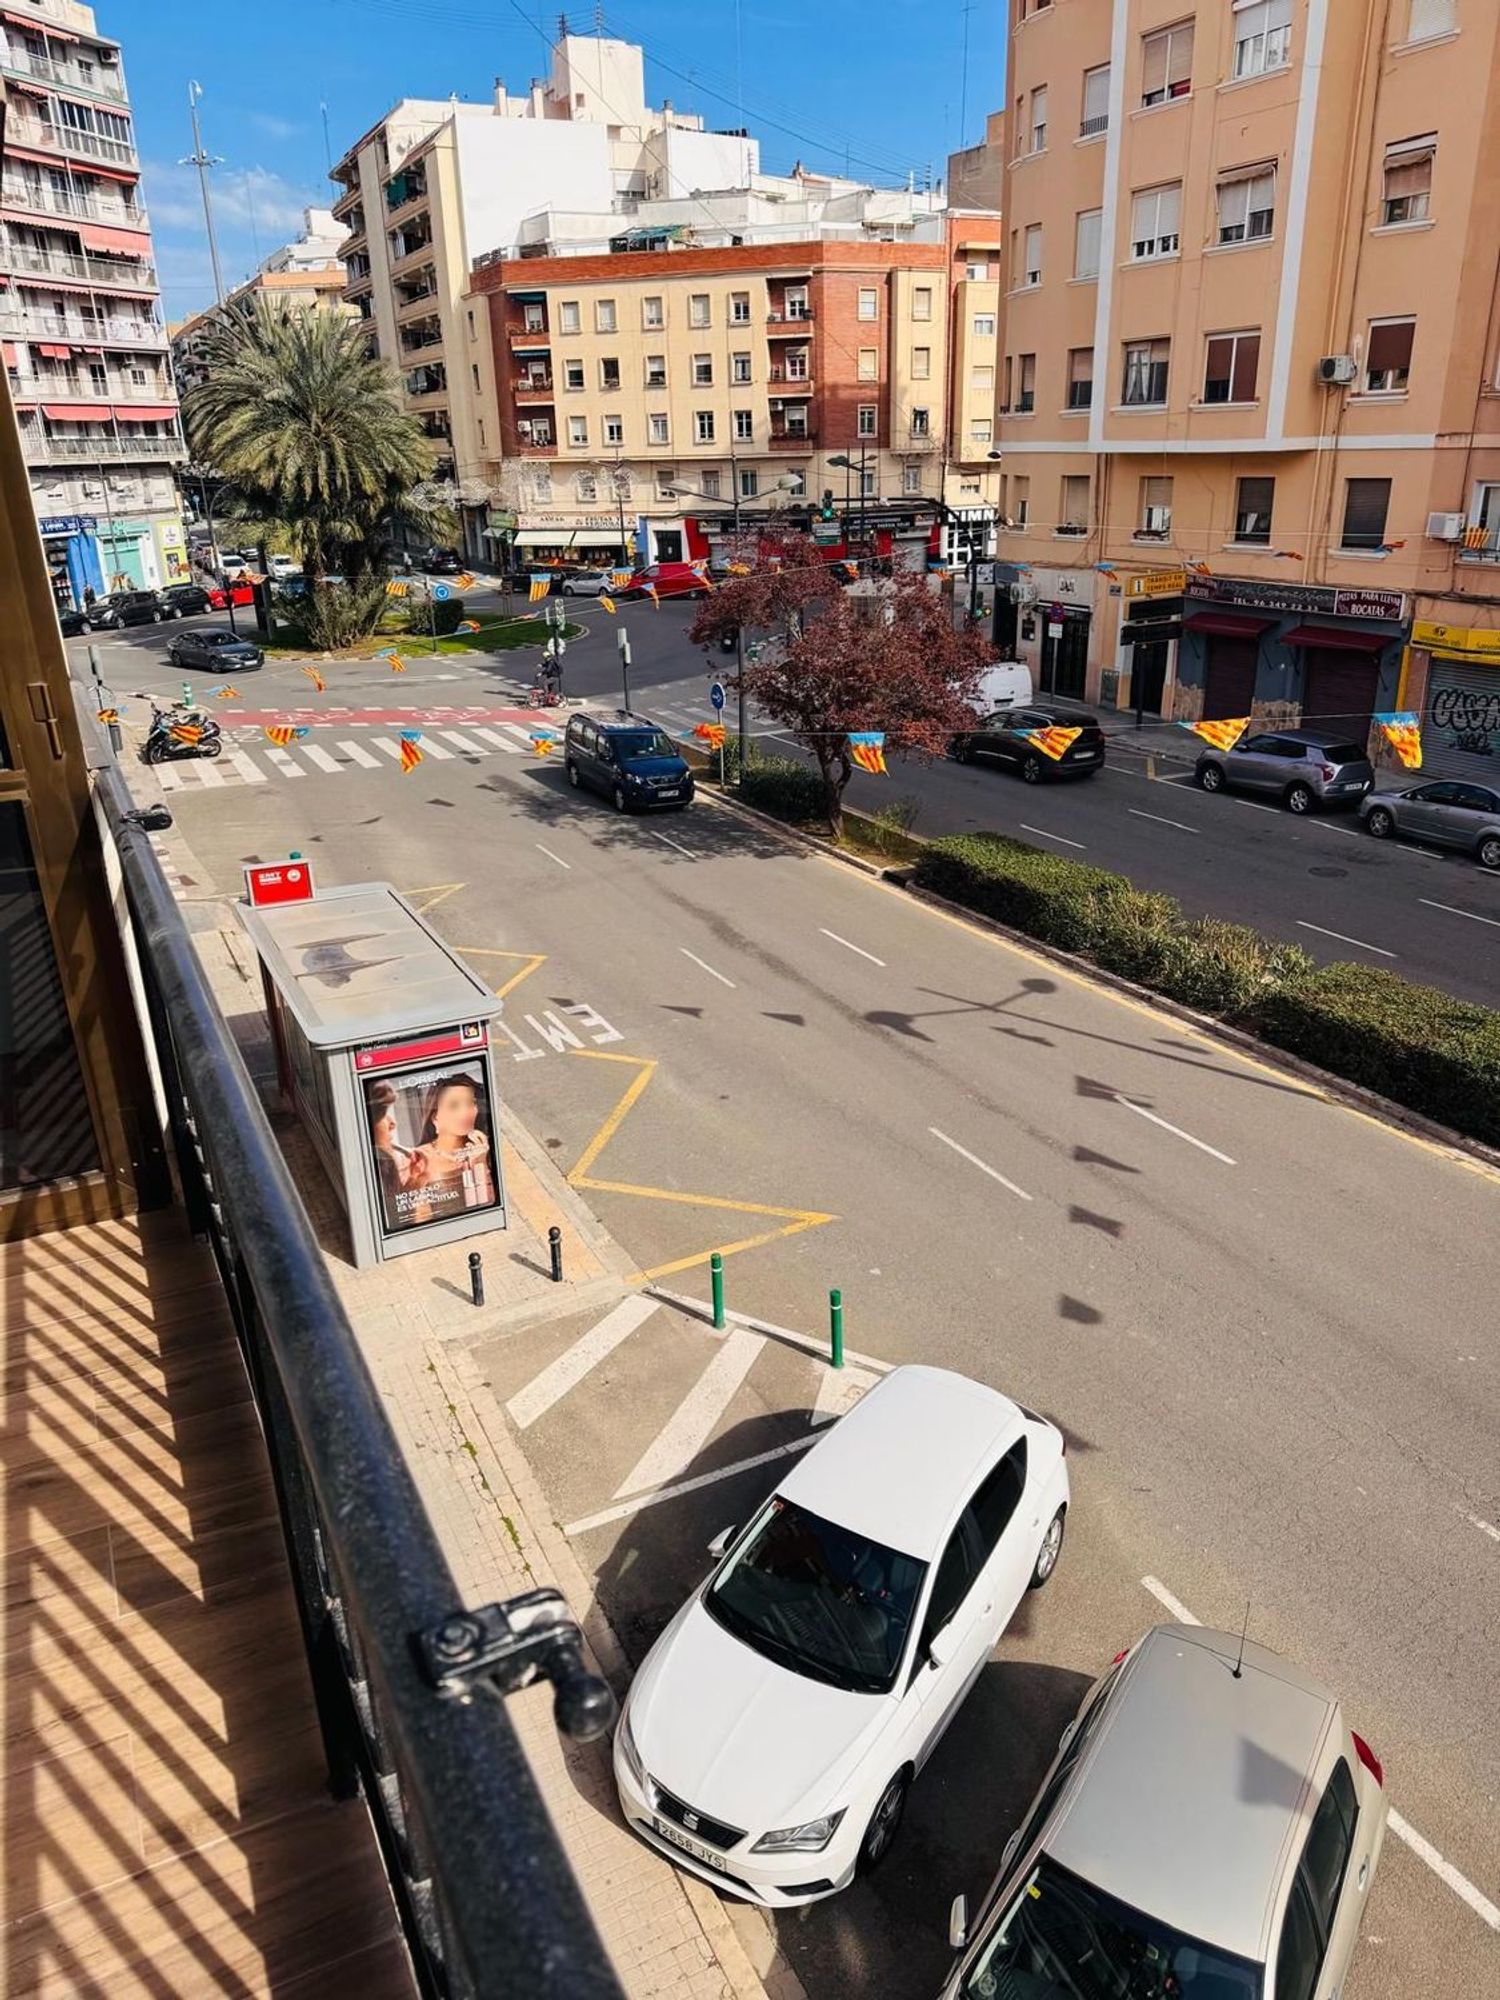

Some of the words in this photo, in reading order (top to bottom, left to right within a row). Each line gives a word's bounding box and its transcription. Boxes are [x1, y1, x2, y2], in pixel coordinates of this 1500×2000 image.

[1360, 590, 1380, 602] PARA
[1350, 603, 1386, 617] BOCATAS
[661, 1823, 693, 1852] 2658
[697, 1846, 723, 1869] JYS
